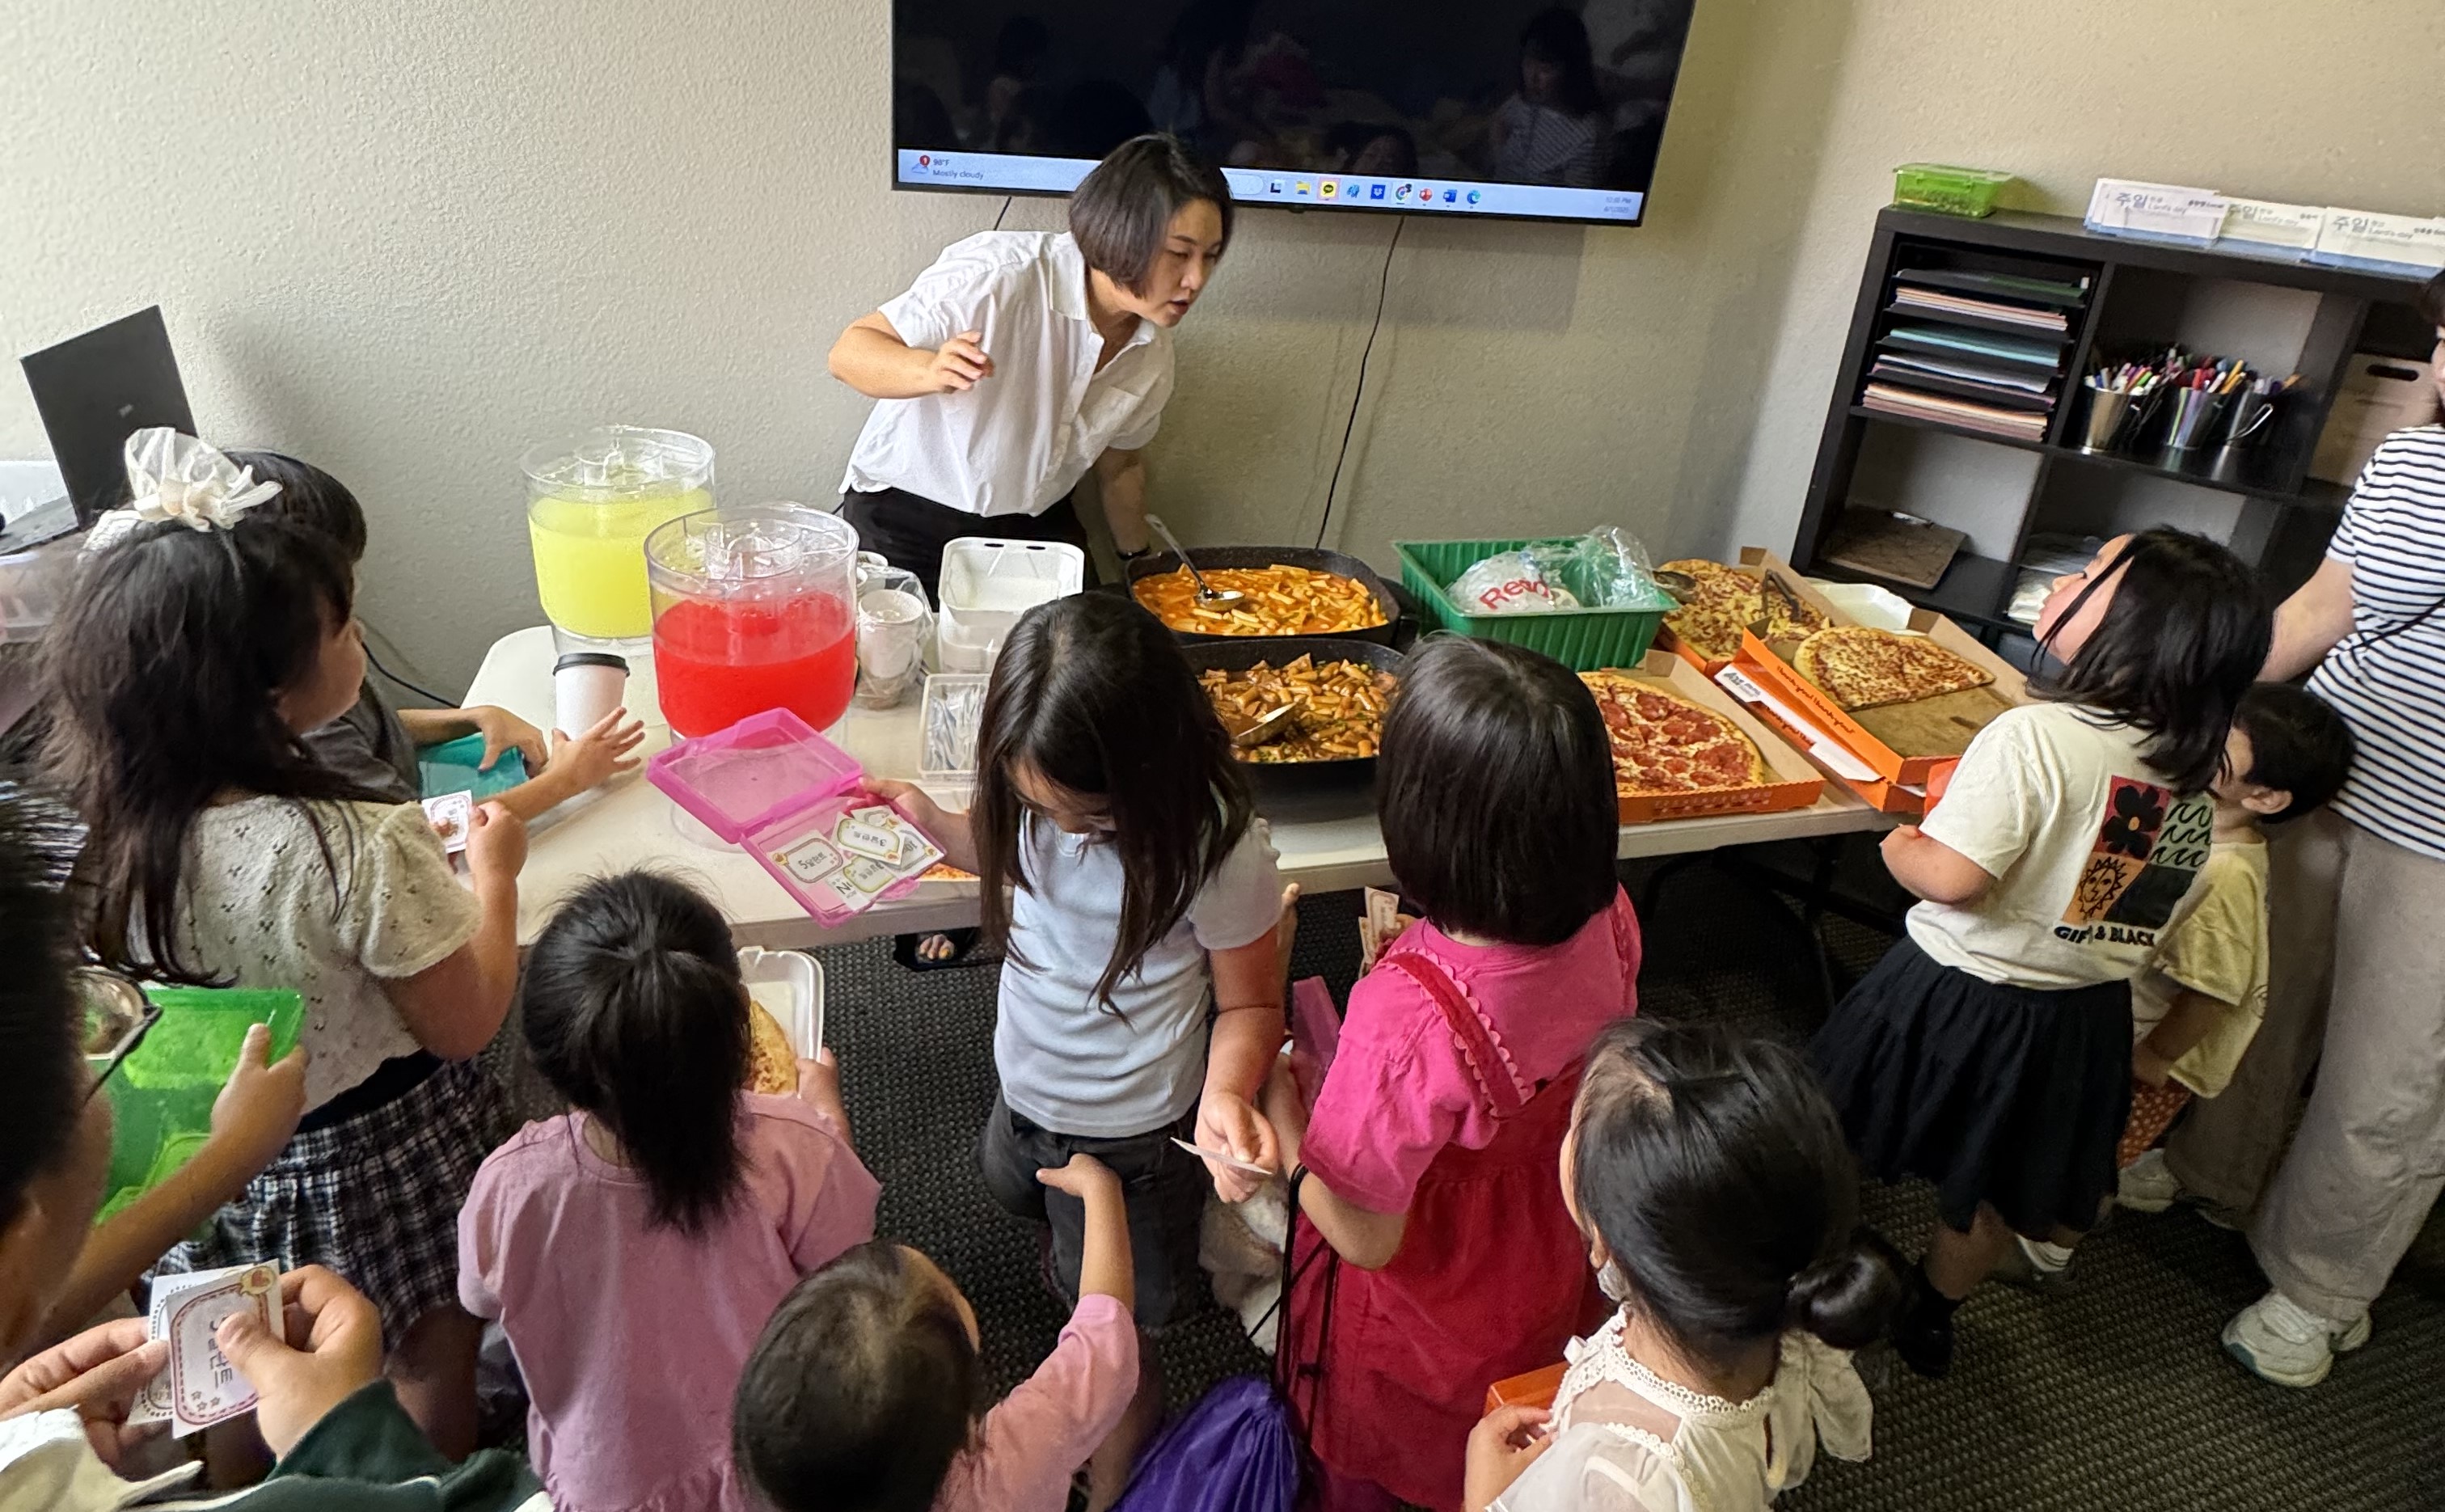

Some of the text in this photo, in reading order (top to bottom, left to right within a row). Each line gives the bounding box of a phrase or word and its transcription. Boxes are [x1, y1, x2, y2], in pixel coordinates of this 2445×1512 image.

[933, 169, 983, 180] Mostly cloudy
[2115, 192, 2147, 209] 주일
[2332, 216, 2368, 233] 주일
